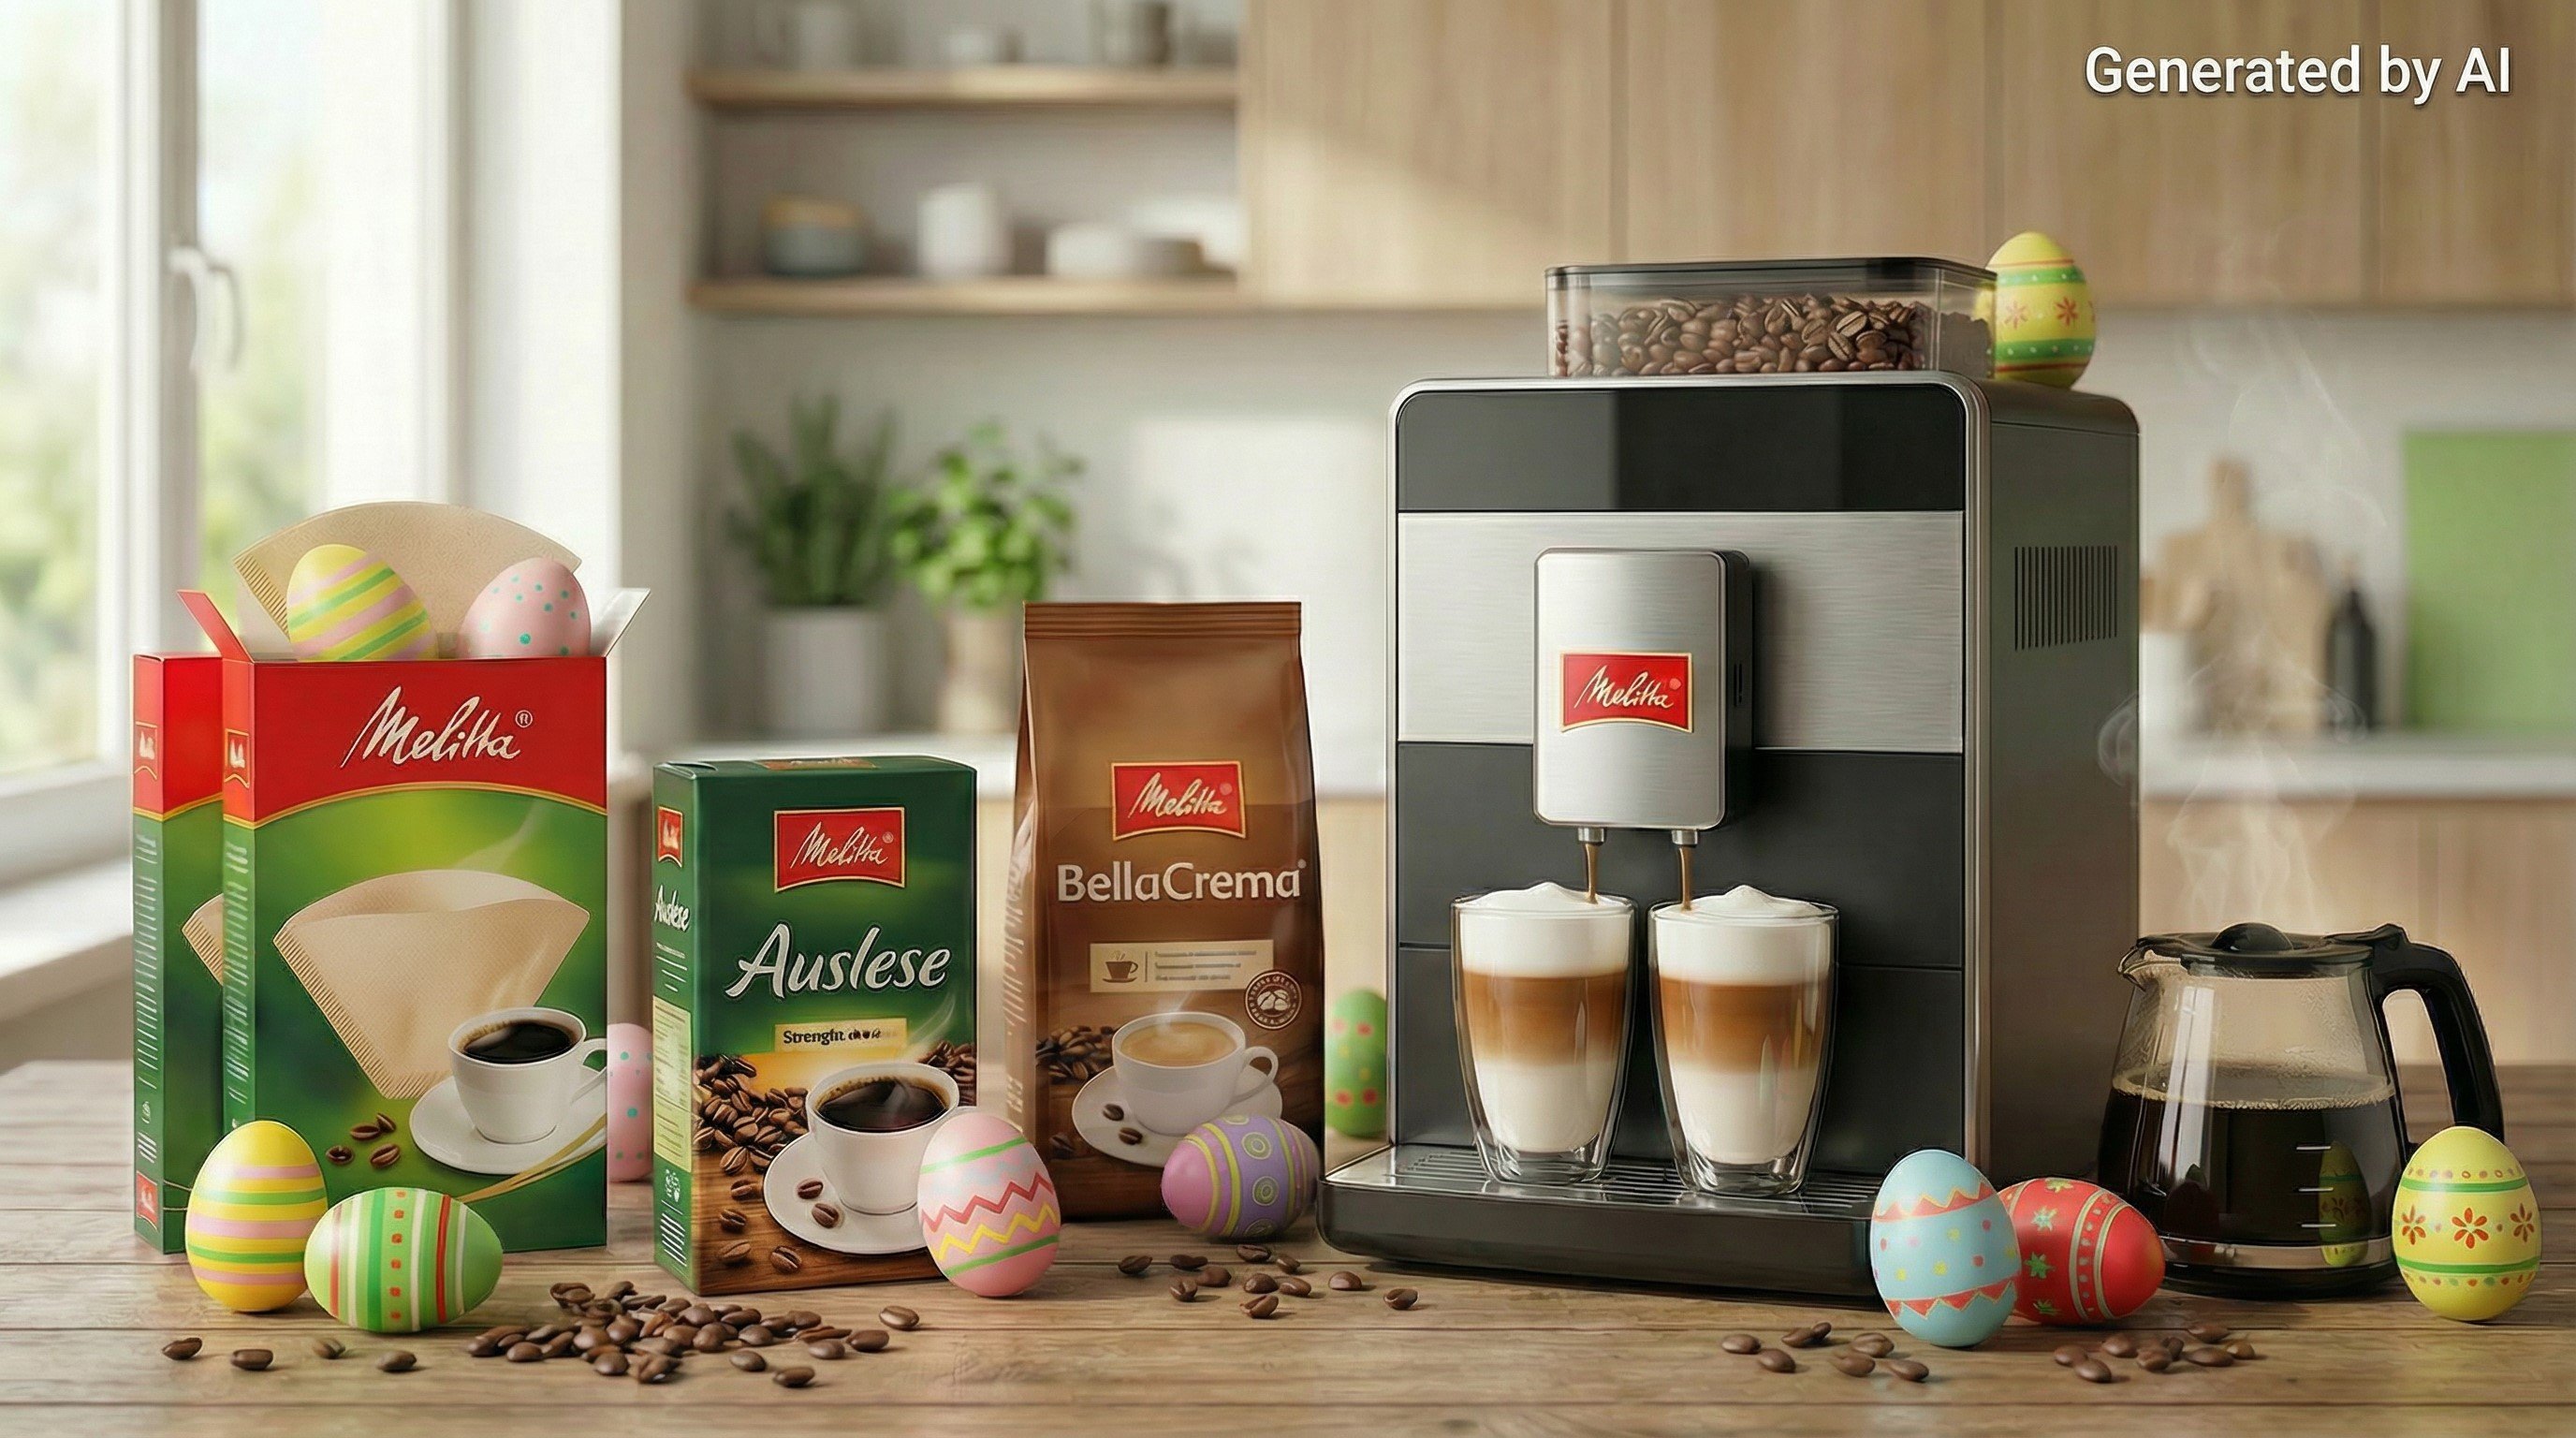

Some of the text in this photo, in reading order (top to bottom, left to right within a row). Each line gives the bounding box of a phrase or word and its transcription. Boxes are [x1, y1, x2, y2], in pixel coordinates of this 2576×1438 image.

[1573, 665, 1675, 709] Melitta
[1127, 771, 1227, 818] Melitta
[789, 821, 889, 869] Melitta
[1057, 859, 1302, 902] BellaCrema
[724, 922, 952, 999] Auslese
